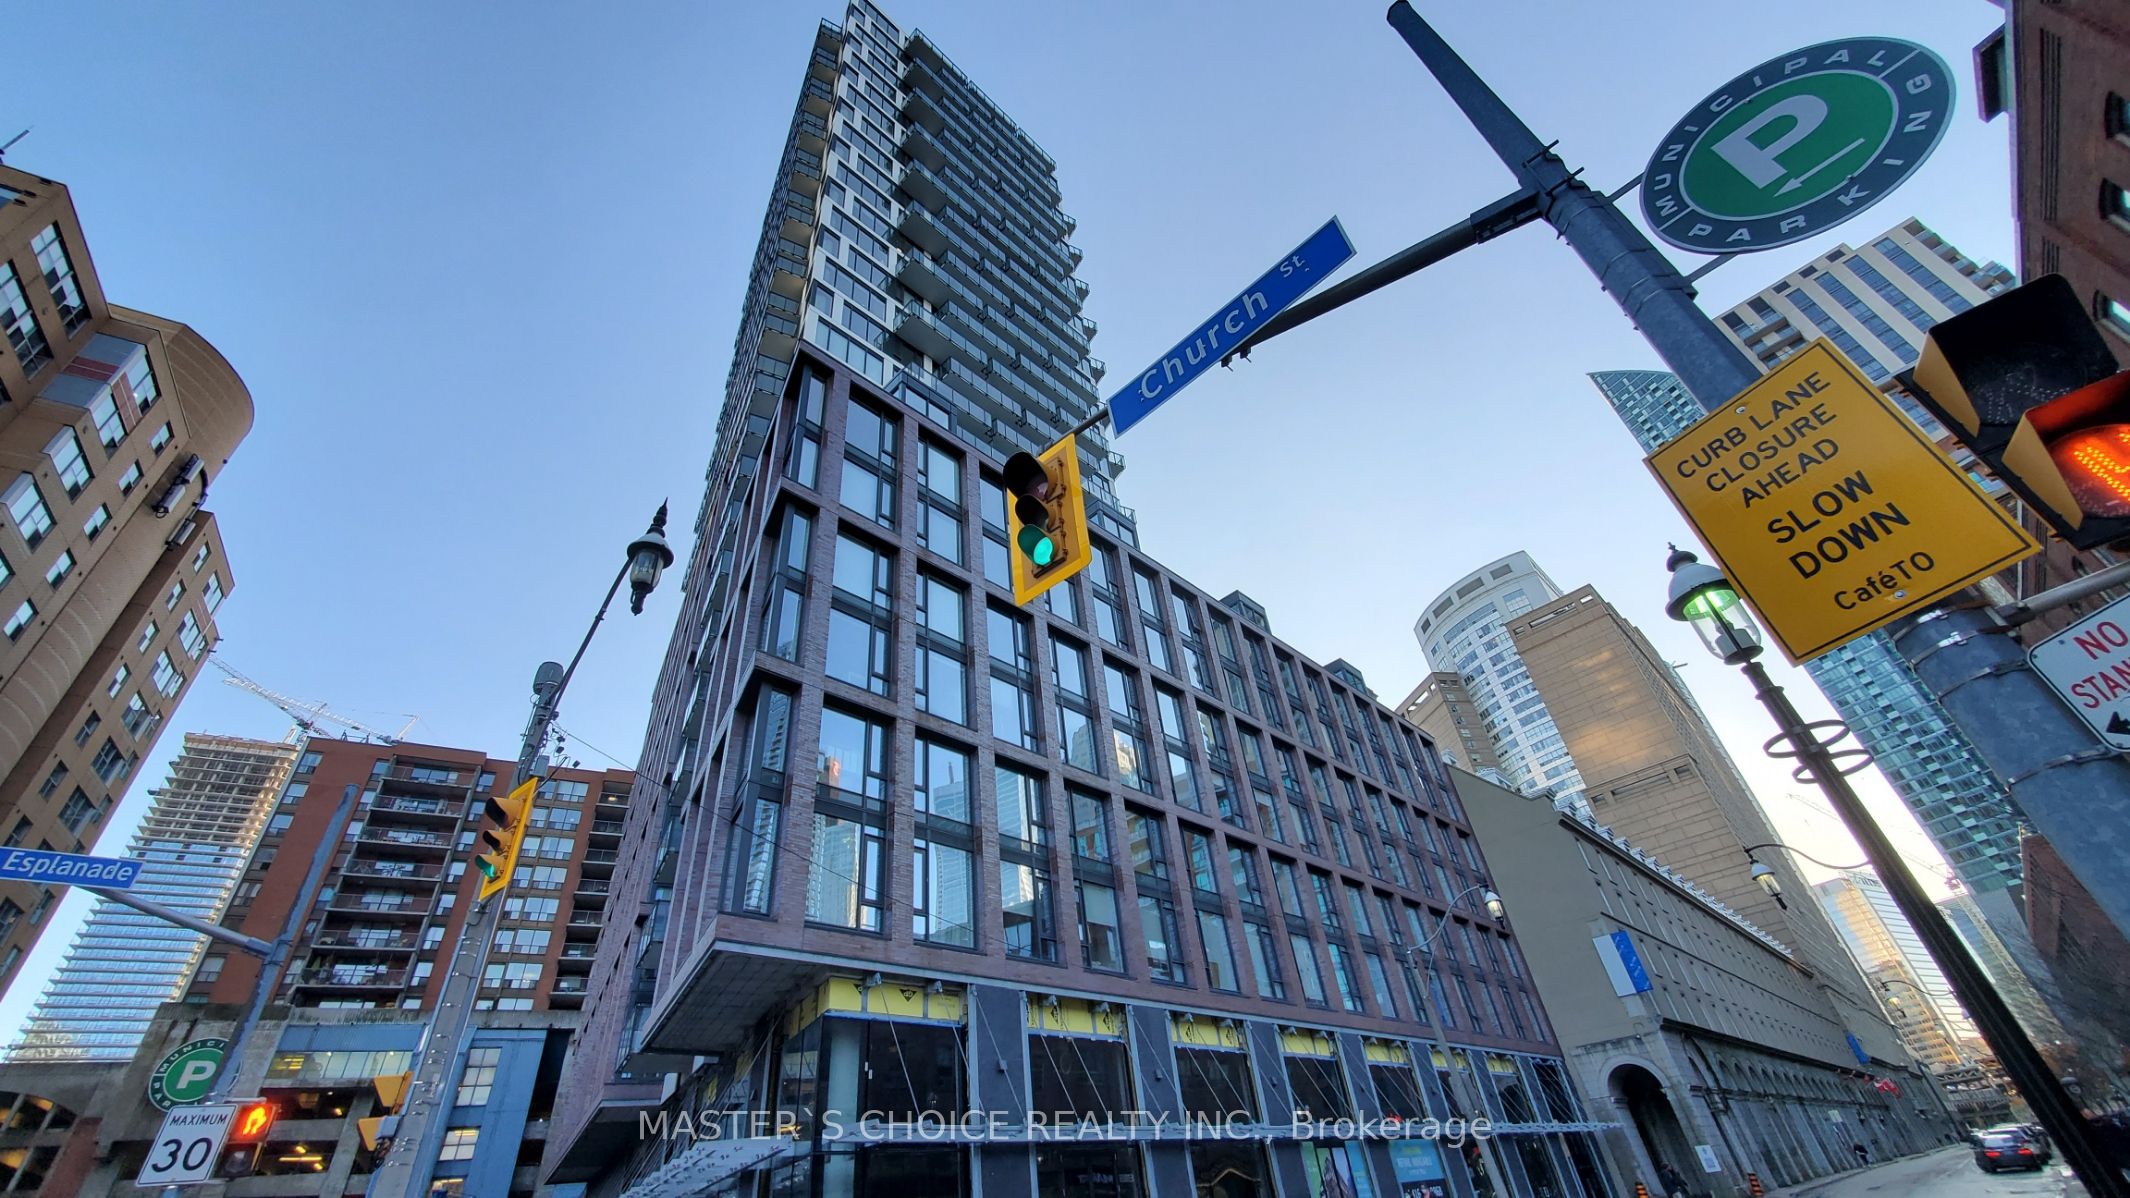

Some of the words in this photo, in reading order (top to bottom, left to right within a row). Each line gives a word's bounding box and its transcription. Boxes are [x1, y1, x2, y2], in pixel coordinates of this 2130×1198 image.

[1654, 48, 1887, 217] MUNICIPAL
[1689, 73, 1933, 242] PARKING
[1710, 94, 1829, 190] P
[1140, 291, 1269, 399] Church
[1279, 254, 1306, 278] St
[1676, 424, 1747, 480] CURB
[1749, 371, 1831, 430] LANE
[1705, 402, 1838, 493] CLOSURE
[1741, 438, 1840, 508] AHEAD
[1767, 469, 1875, 545] SLOW
[1787, 502, 1911, 580] DOWN
[1834, 551, 1935, 611] CaféTO
[2073, 621, 2129, 660] NO
[2071, 657, 2130, 709] STAN
[2, 851, 133, 881] Esplanade
[159, 1041, 225, 1073] MUNICI
[176, 1060, 217, 1090] P
[151, 1137, 213, 1173] 30
[170, 1114, 228, 1127] MAXIMUM
